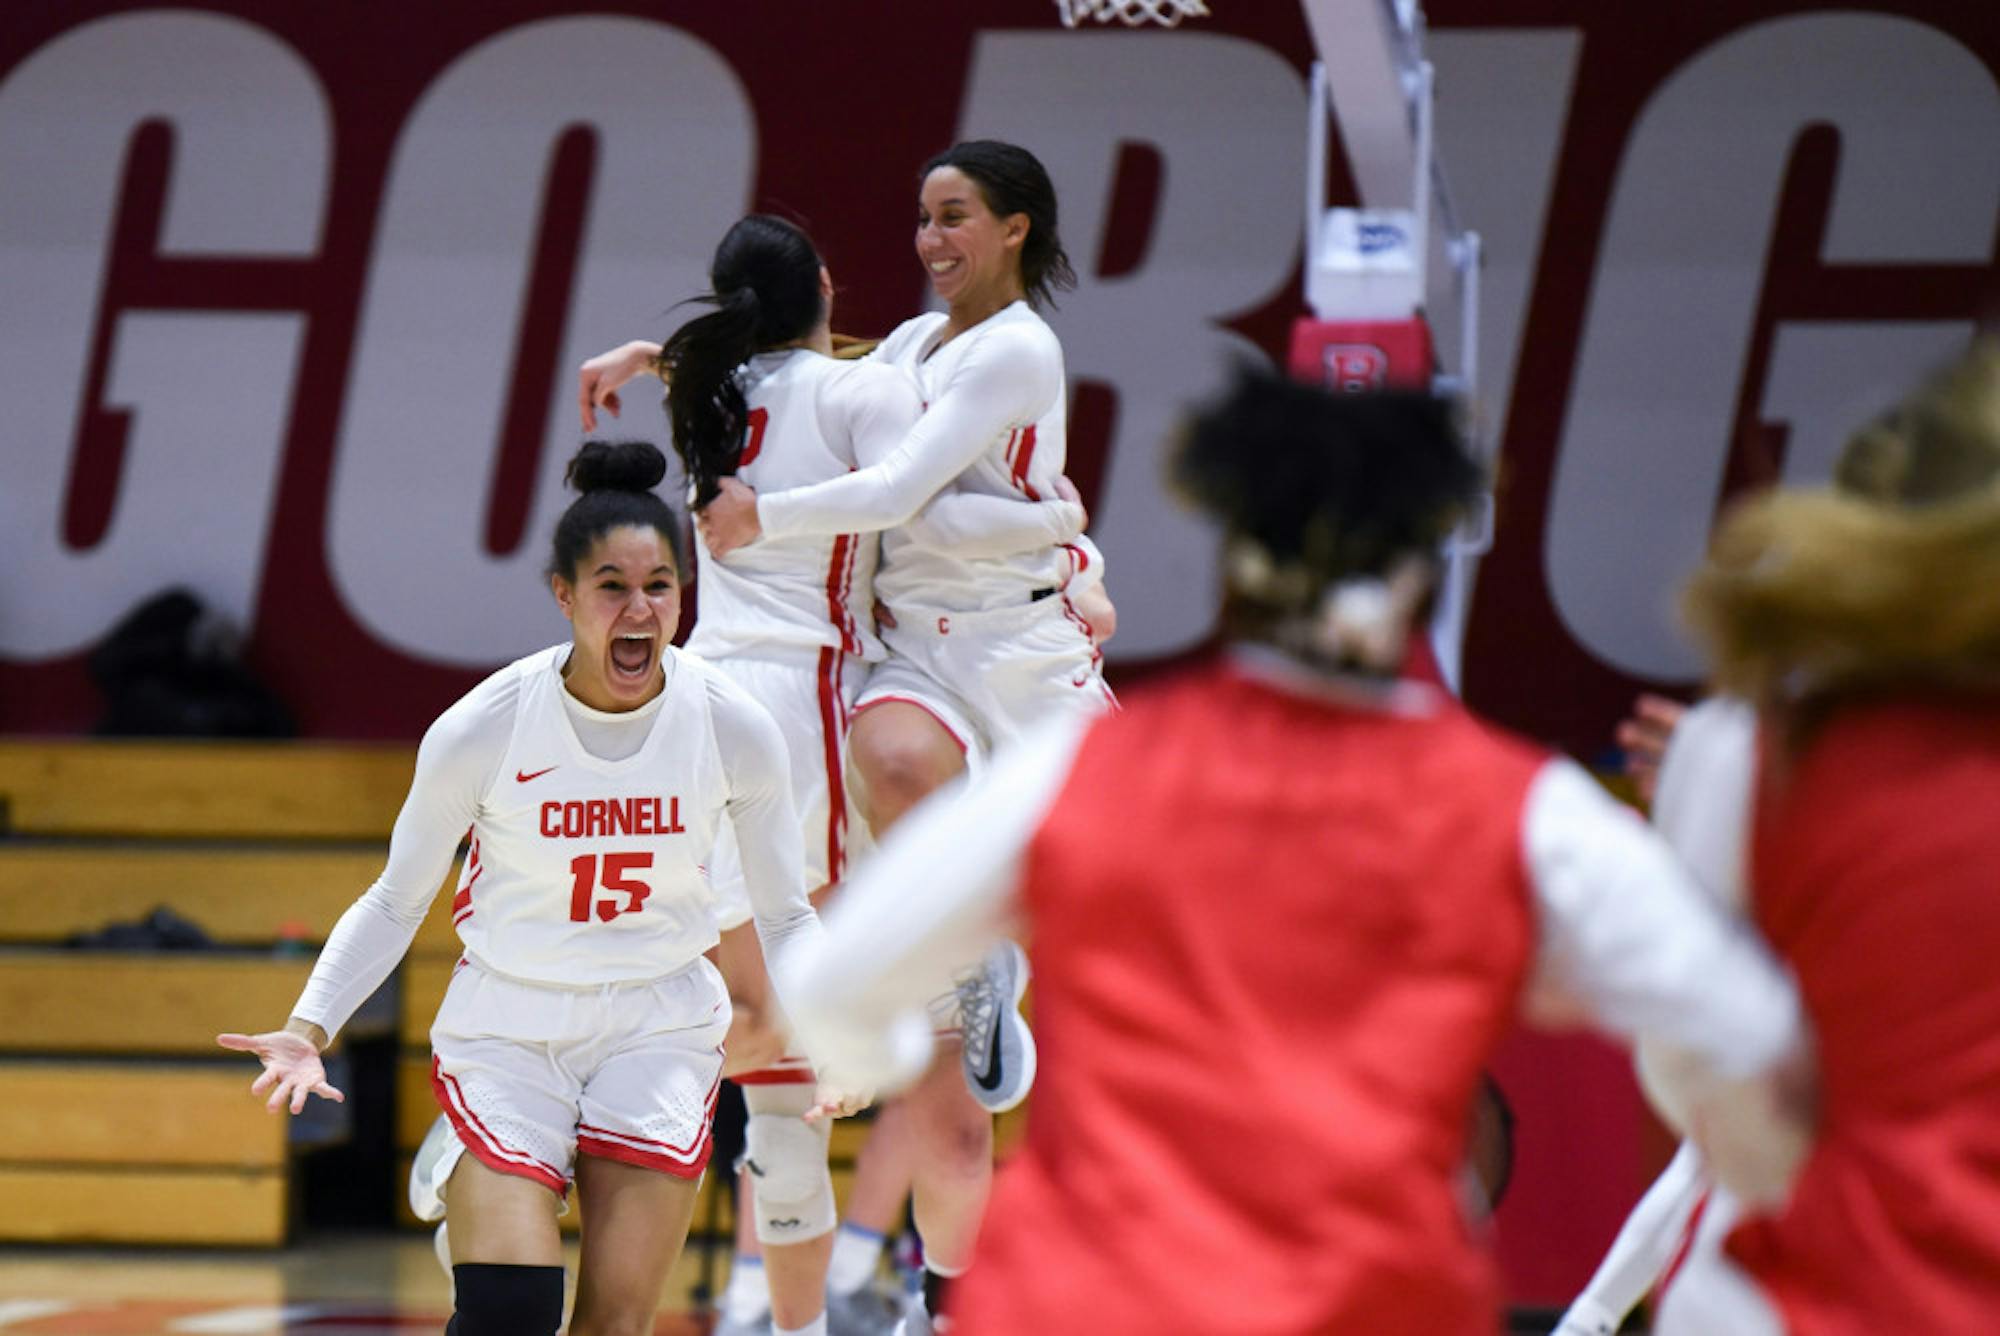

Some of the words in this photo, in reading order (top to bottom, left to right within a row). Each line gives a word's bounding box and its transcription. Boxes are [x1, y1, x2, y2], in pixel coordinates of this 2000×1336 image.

[0, 9, 757, 667] GO
[937, 617, 950, 635] C
[540, 796, 686, 838] CORNELL
[569, 852, 654, 923] 15
